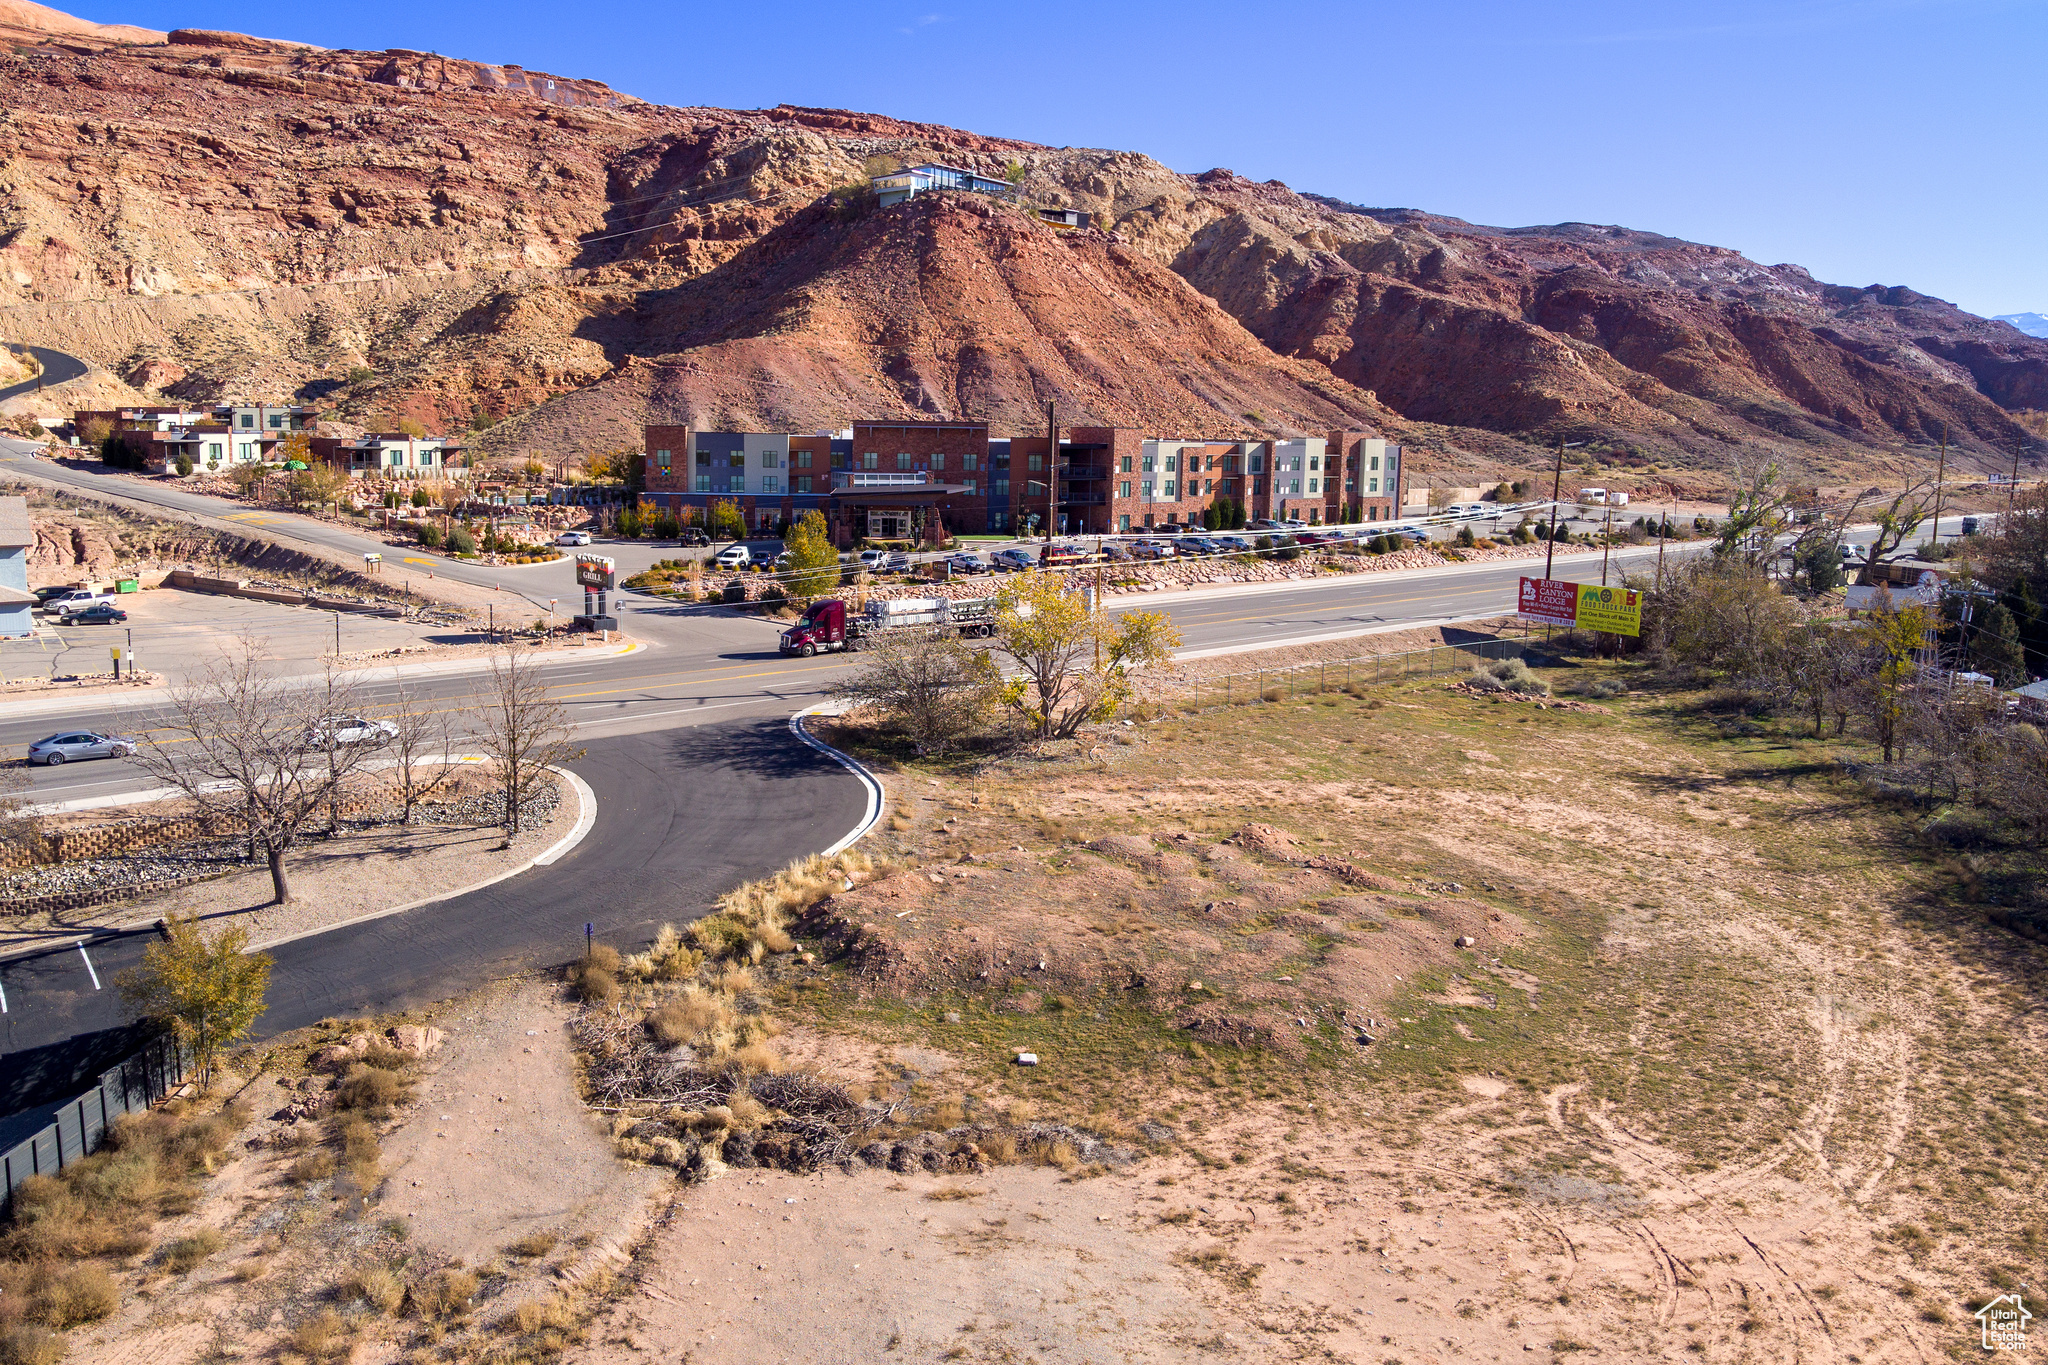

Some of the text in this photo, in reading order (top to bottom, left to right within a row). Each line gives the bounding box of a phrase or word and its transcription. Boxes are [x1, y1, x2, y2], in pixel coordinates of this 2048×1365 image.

[583, 571, 602, 582] GRILL
[1540, 580, 1564, 590] RIVER
[1539, 588, 1573, 598] CANYON
[1582, 587, 1637, 606] MOAB
[1539, 595, 1565, 605] LODGE
[1581, 600, 1636, 613] FOOD TRUCK PARK
[1622, 622, 1635, 630] Seating
